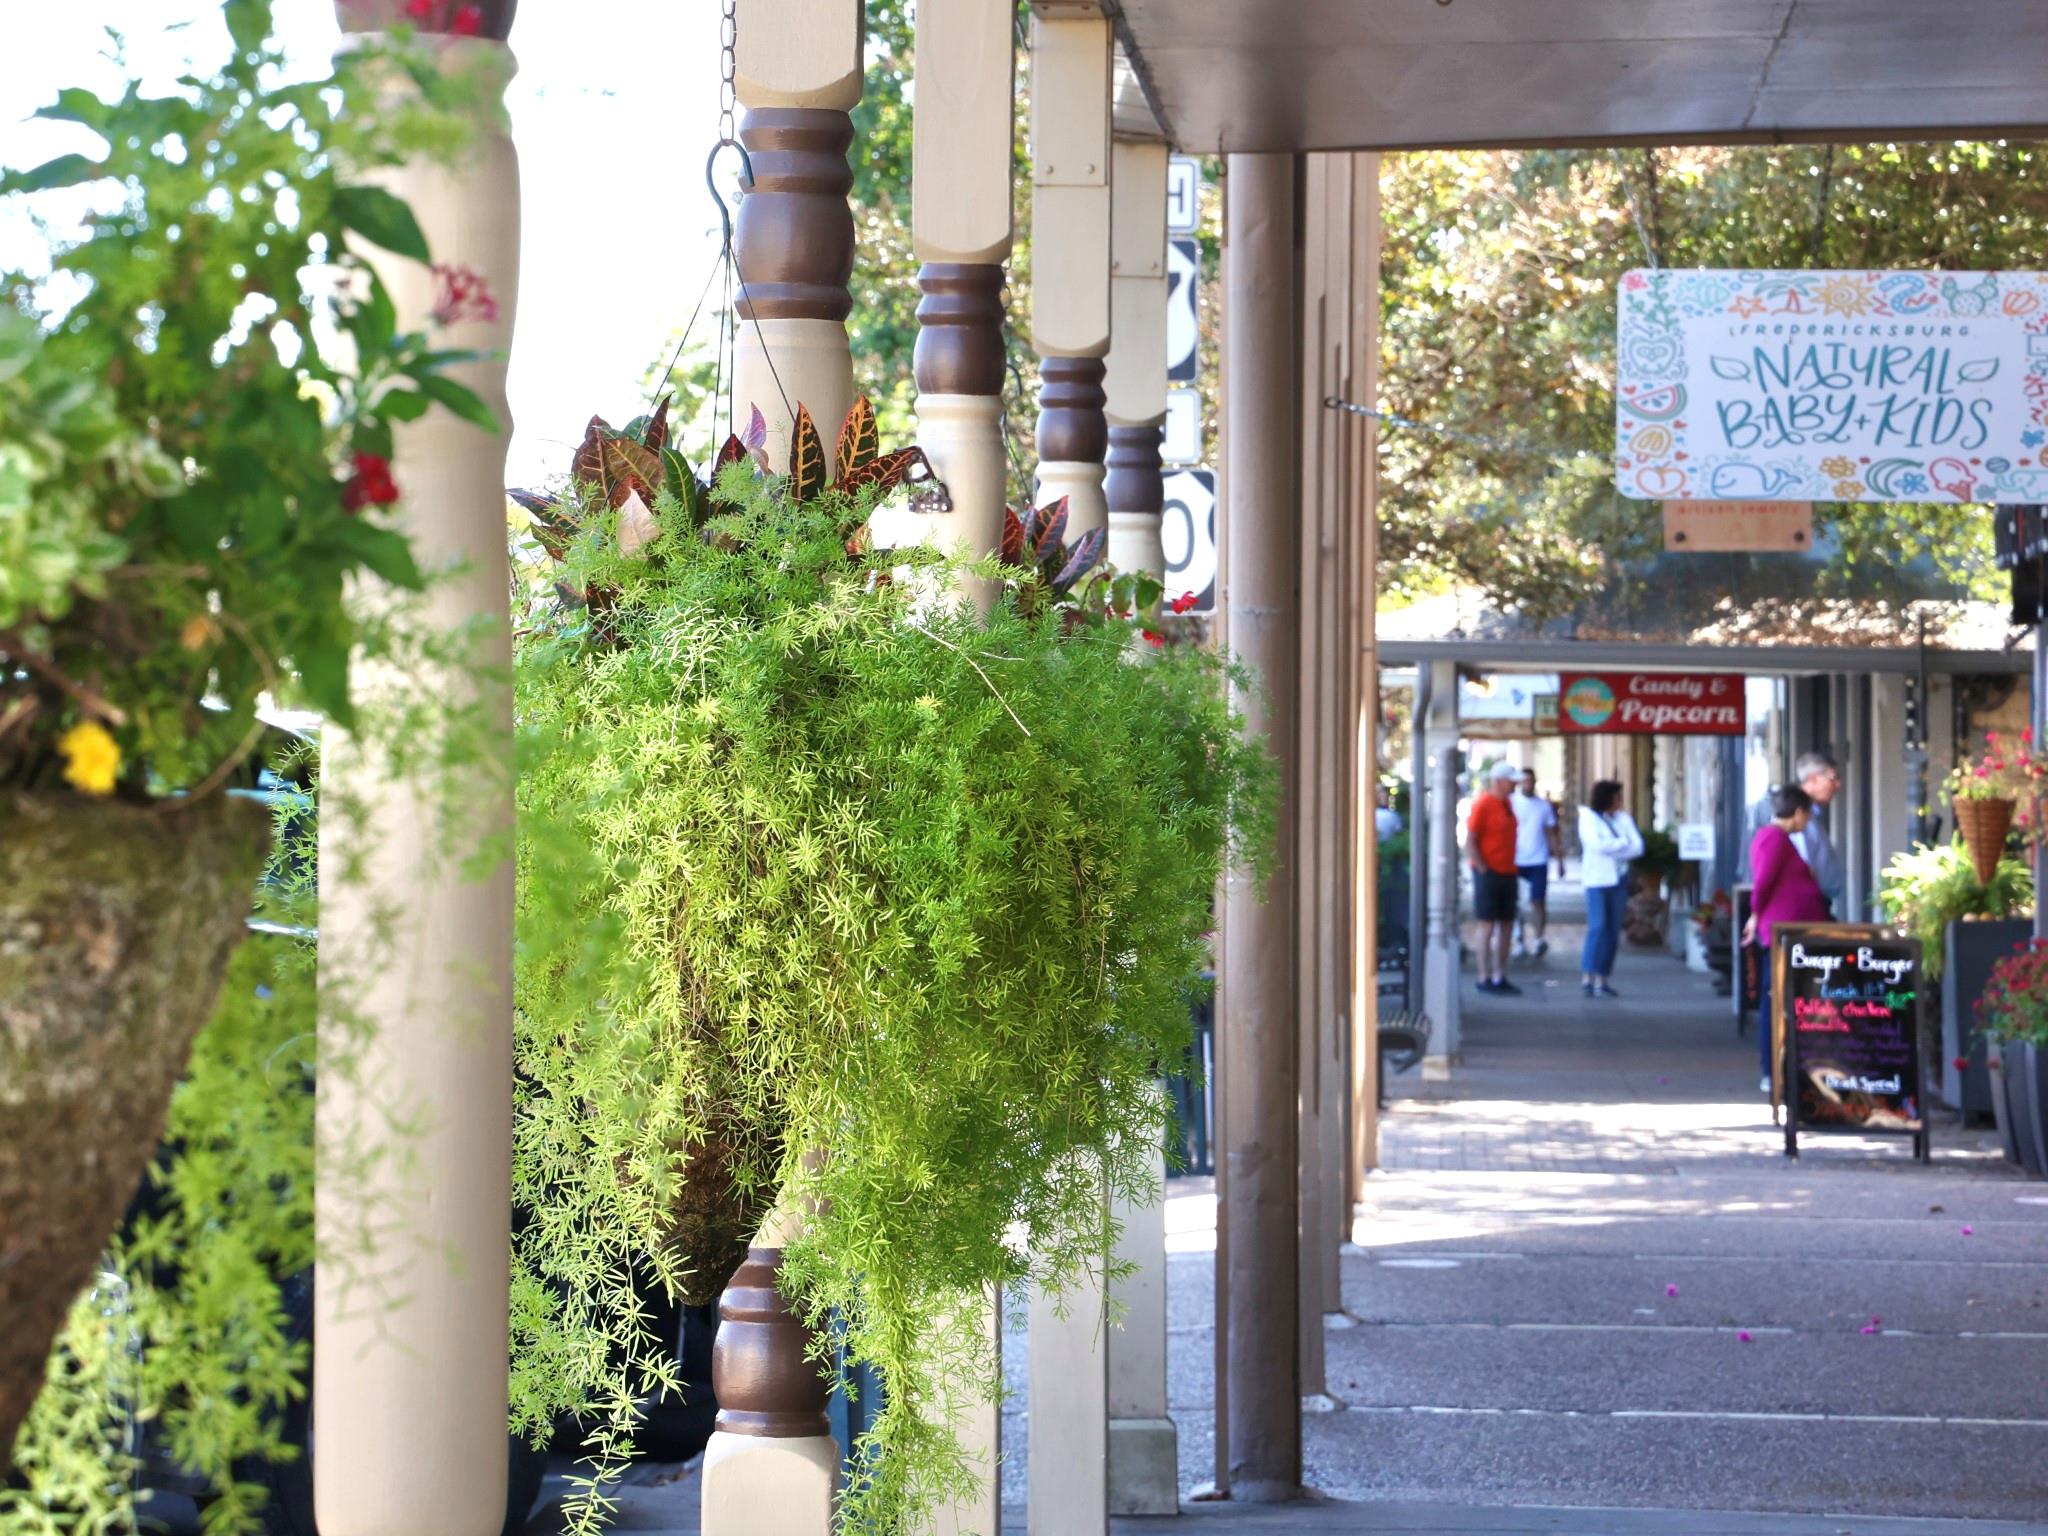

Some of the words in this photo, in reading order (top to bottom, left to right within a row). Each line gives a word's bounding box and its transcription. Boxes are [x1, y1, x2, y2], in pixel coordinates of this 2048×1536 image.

[1753, 342, 1955, 395] NATURAL
[1629, 675, 1704, 699] Candy
[1709, 677, 1728, 693] &
[1617, 699, 1739, 728] Popcorn
[1791, 943, 1843, 984] Burger
[1857, 946, 1914, 984] Burger
